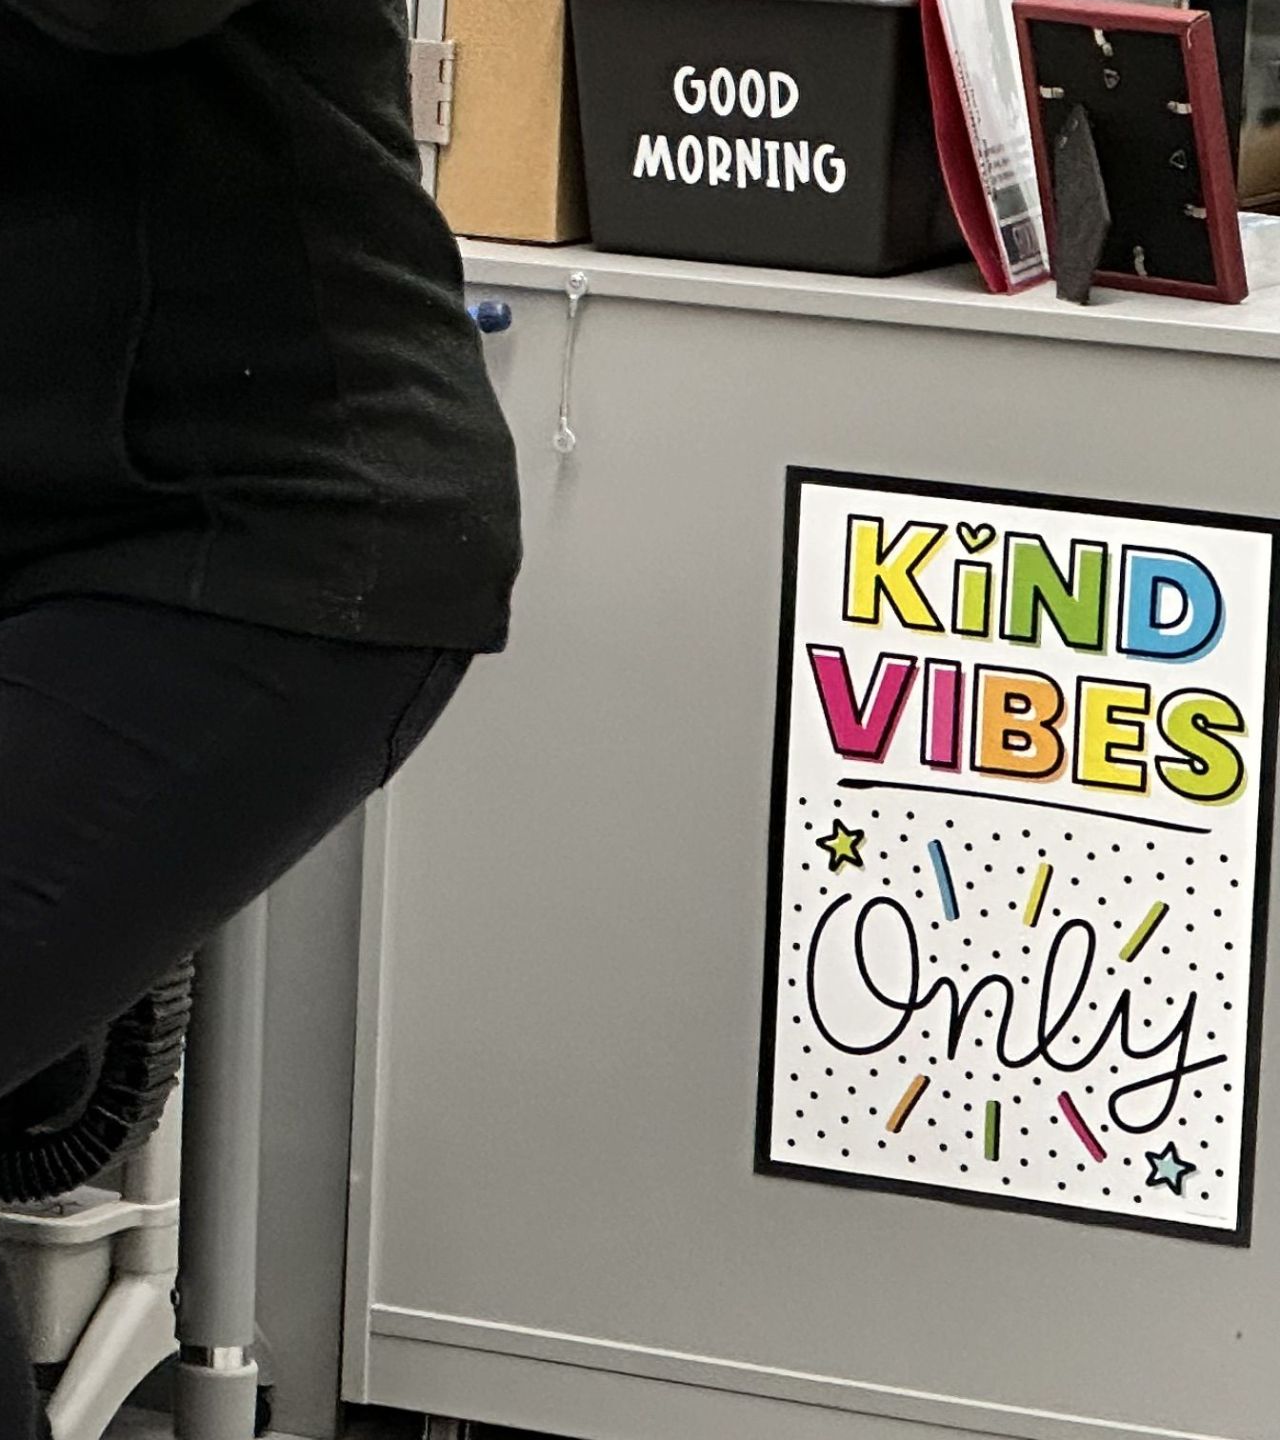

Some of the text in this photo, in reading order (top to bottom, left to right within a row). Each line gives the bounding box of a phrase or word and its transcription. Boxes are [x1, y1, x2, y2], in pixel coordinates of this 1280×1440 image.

[673, 65, 799, 120] GOOD
[633, 135, 847, 195] MORNING
[806, 643, 1248, 806] VIBES
[807, 892, 1228, 1135] Only
